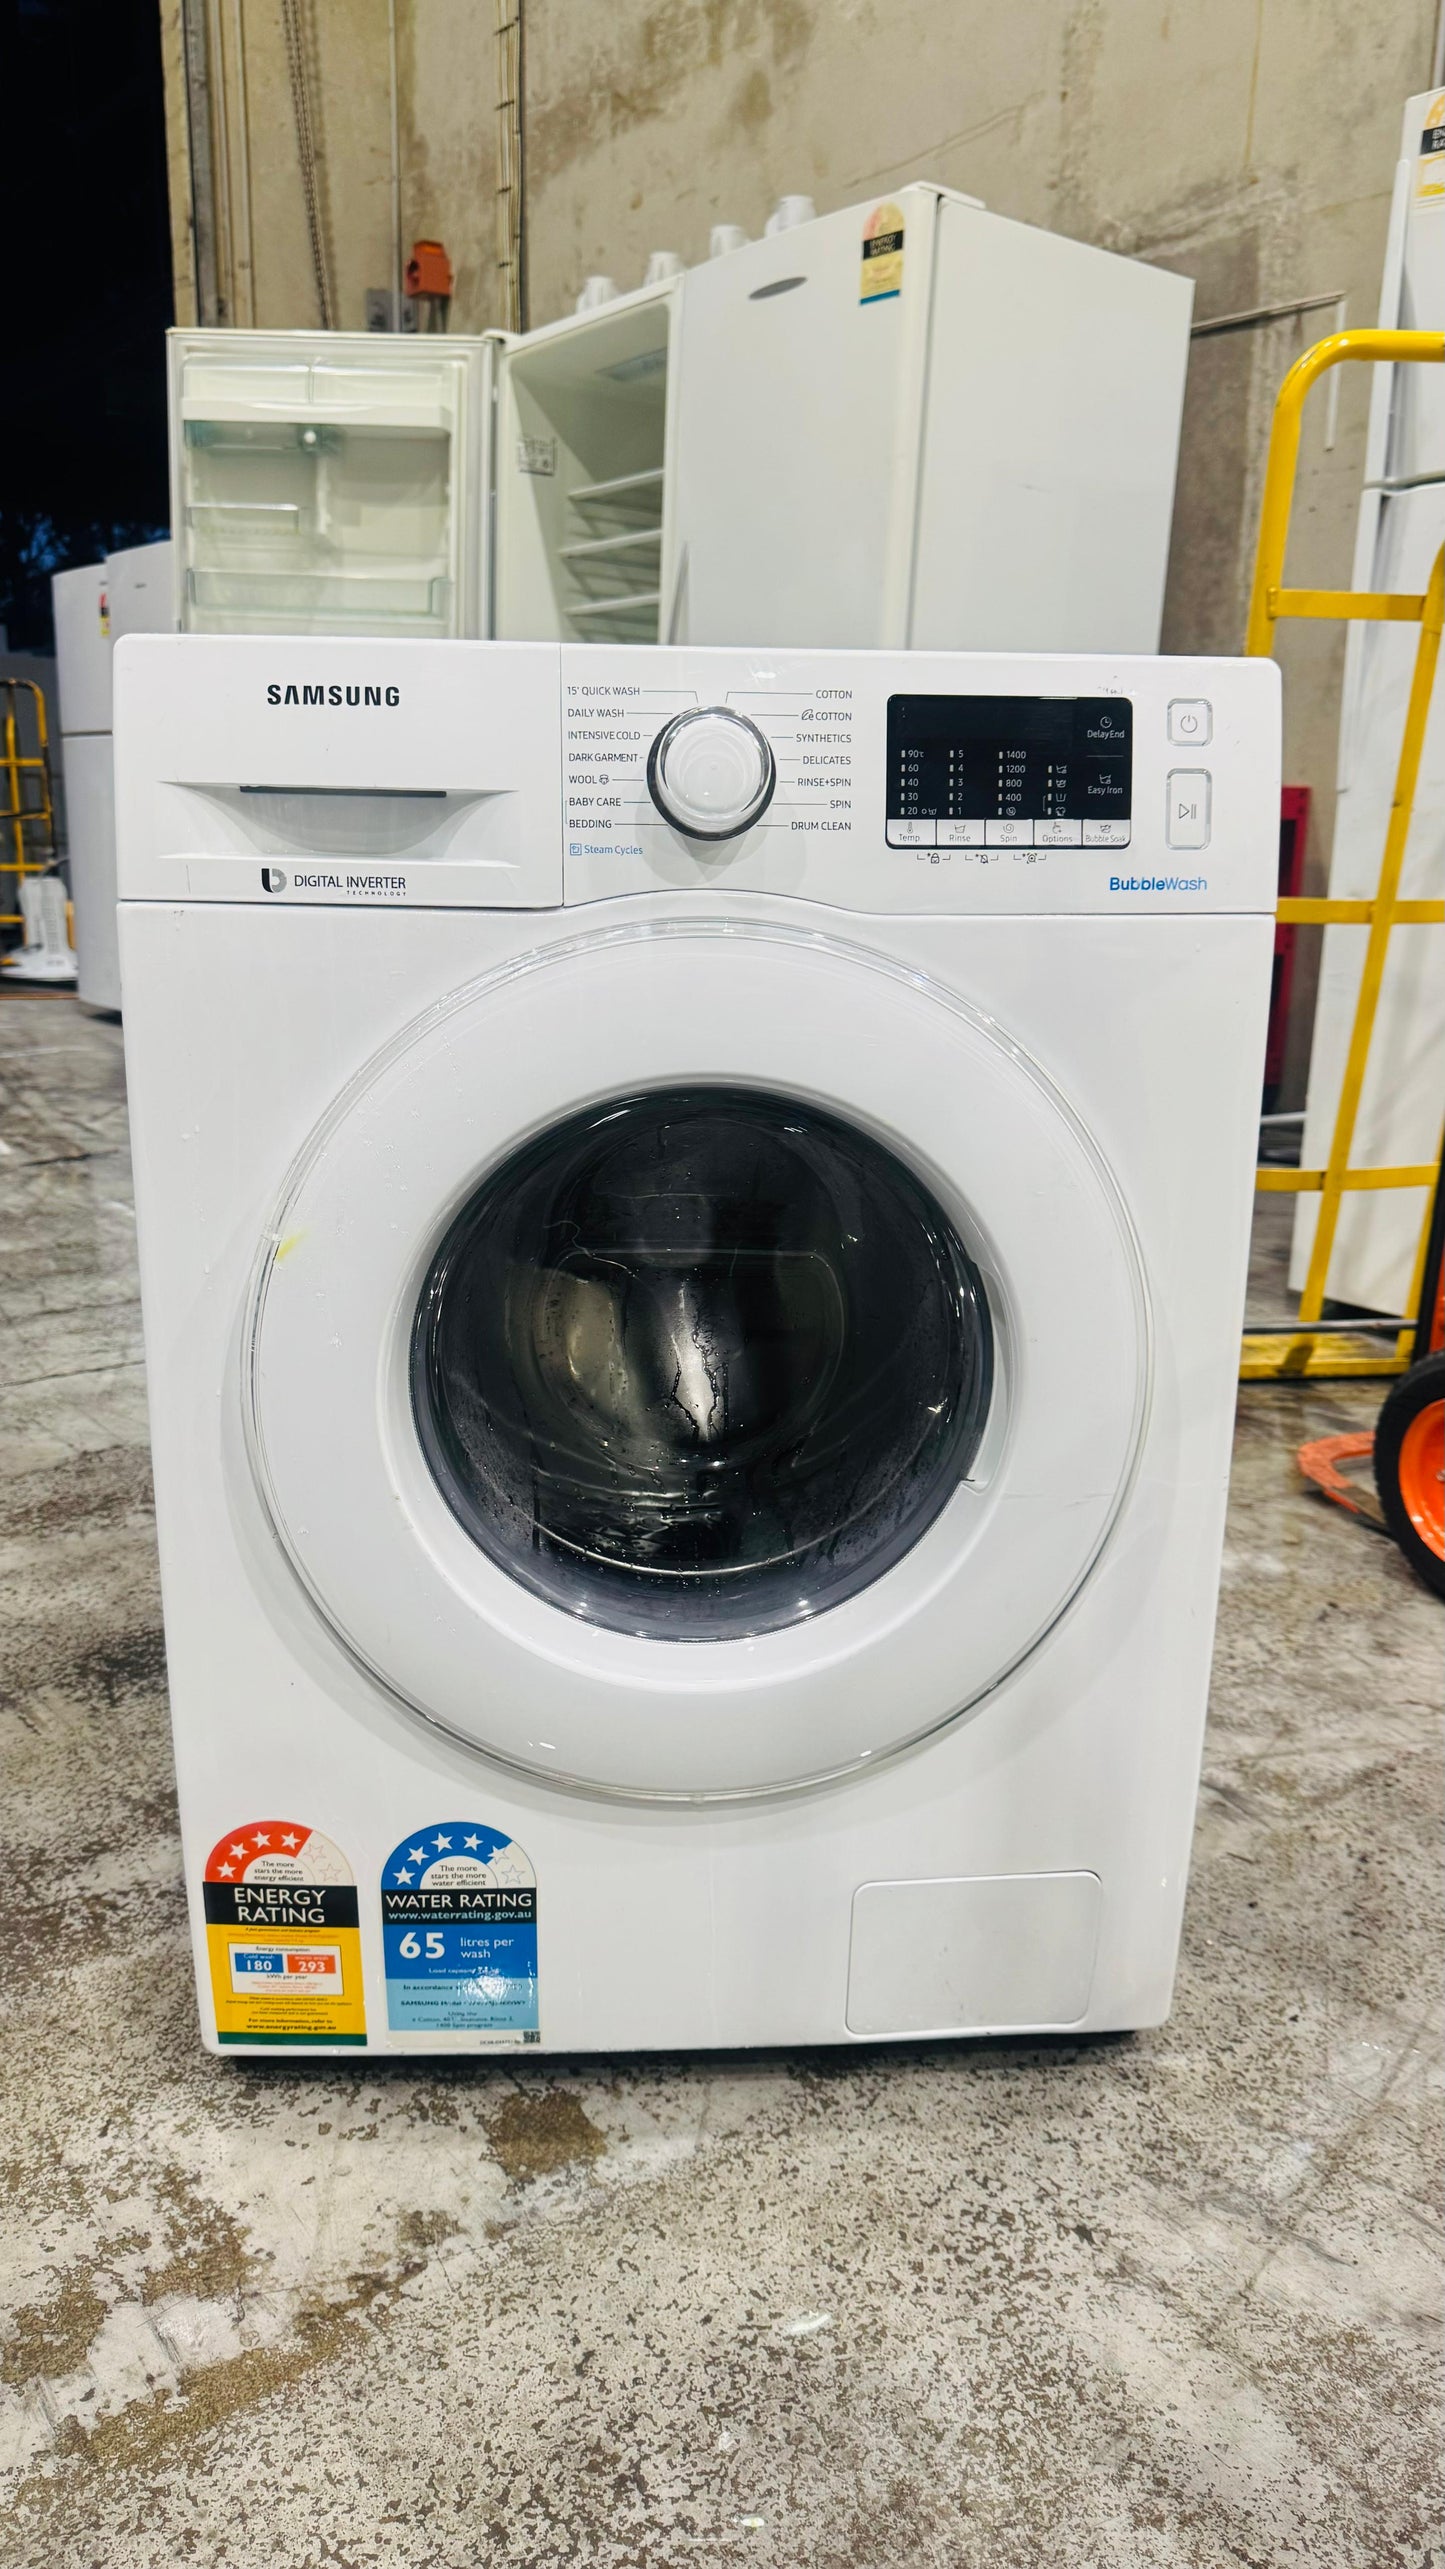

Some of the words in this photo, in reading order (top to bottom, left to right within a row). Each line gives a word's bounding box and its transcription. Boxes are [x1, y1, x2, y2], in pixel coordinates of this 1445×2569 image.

[267, 684, 400, 706] SAMSUNG
[581, 686, 611, 696] QUICK
[612, 686, 640, 696] WASH
[816, 690, 852, 699] COTTON
[567, 708, 594, 717] DAILY
[596, 708, 624, 717] WASH
[816, 712, 852, 720] COTTON
[568, 731, 615, 740] INTENSIVE
[616, 731, 641, 740] COLD
[796, 734, 852, 743] SYNTHETICS
[568, 753, 594, 762] DARK
[594, 753, 638, 762] GARMENT
[958, 750, 964, 758] 5
[1007, 751, 1026, 759] 1400
[802, 756, 852, 765] DELICATES
[908, 764, 919, 772] 60
[958, 764, 964, 772] 4
[1007, 765, 1026, 773] 1200
[568, 775, 597, 784] WOOL
[797, 778, 852, 786] RINSE+SPIN
[908, 778, 919, 786] 40
[1006, 779, 1022, 787] 800
[1087, 786, 1106, 795] Easy
[1107, 786, 1122, 794] Iron
[1006, 793, 1022, 801] 400
[569, 798, 594, 806] BABY
[596, 798, 621, 806] CARE
[830, 800, 852, 808] SPIN
[908, 807, 918, 815] 20
[569, 819, 612, 828] BEDDING
[792, 822, 819, 830] DRUM
[821, 822, 851, 830] CLEAN
[899, 834, 920, 842] Temp
[949, 834, 971, 842] Rinse
[1000, 834, 1017, 842] Spin
[1042, 835, 1072, 843] Options
[584, 845, 613, 854] Steam
[614, 845, 643, 856] Cycles
[294, 875, 343, 887] DIGITAL
[347, 876, 406, 889] INVERTER
[1110, 877, 1207, 890] BubbleWash
[234, 1887, 326, 1905] ENERGY
[386, 1895, 452, 1908] WATER
[460, 1894, 532, 1907] RATING
[238, 1906, 325, 1924] RATING
[388, 1911, 531, 1920] www.waterrating.gov.au
[400, 1932, 445, 1959] 65
[460, 1937, 490, 1947] litres
[493, 1939, 514, 1949] per
[461, 1950, 490, 1958] wash
[247, 1960, 272, 1971] 180
[298, 1961, 326, 1972] 293
